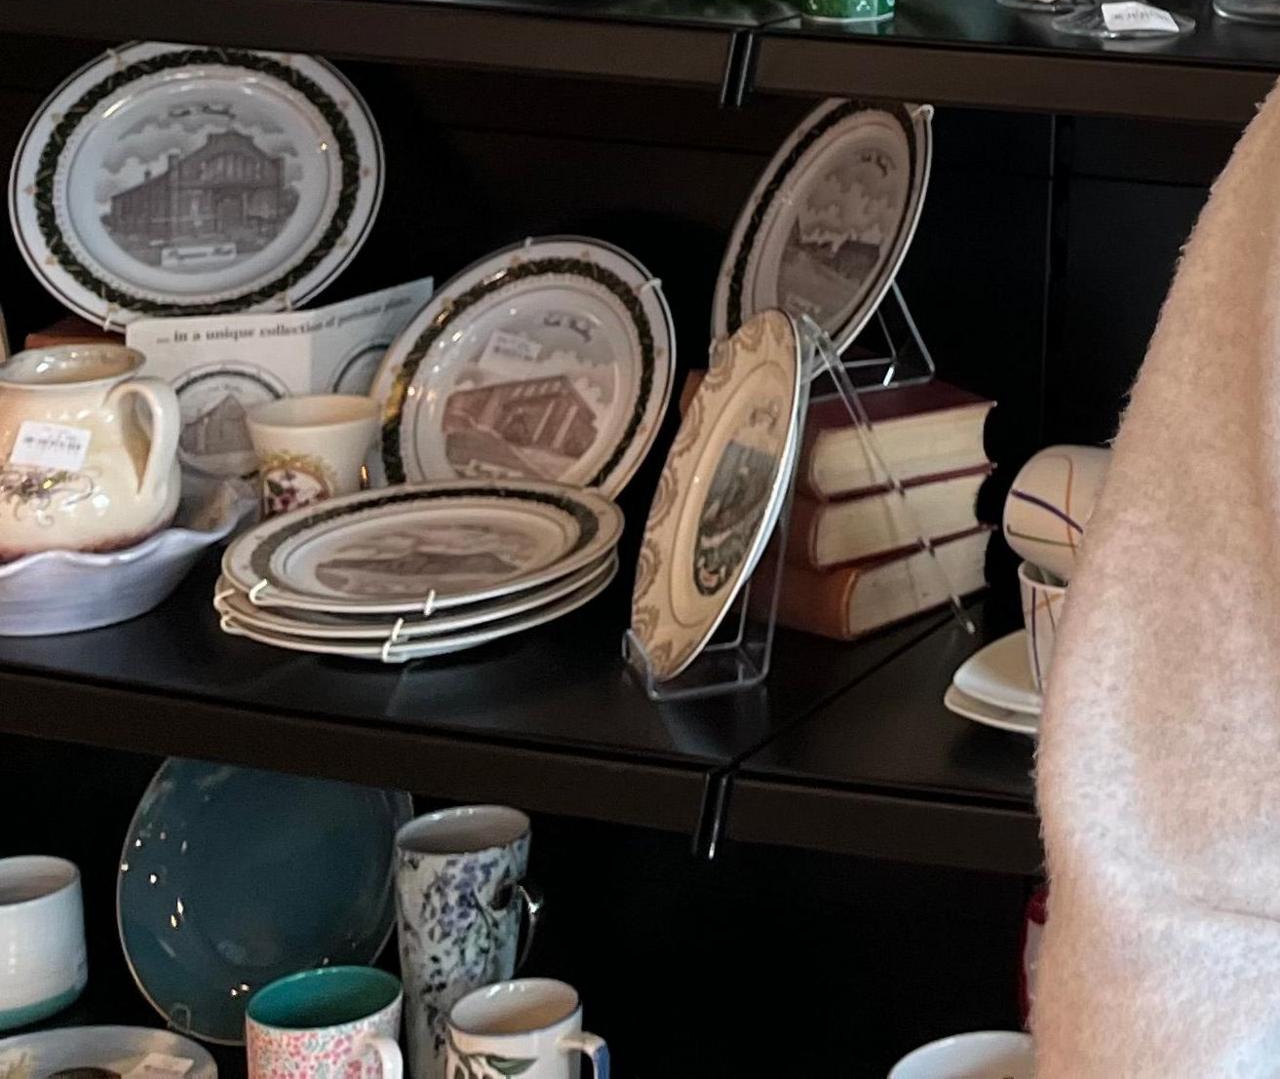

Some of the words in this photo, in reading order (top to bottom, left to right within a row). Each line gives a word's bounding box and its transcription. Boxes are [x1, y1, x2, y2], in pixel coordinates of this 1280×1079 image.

[174, 329, 188, 343] in
[206, 328, 254, 342] unique
[259, 322, 323, 339] collection
